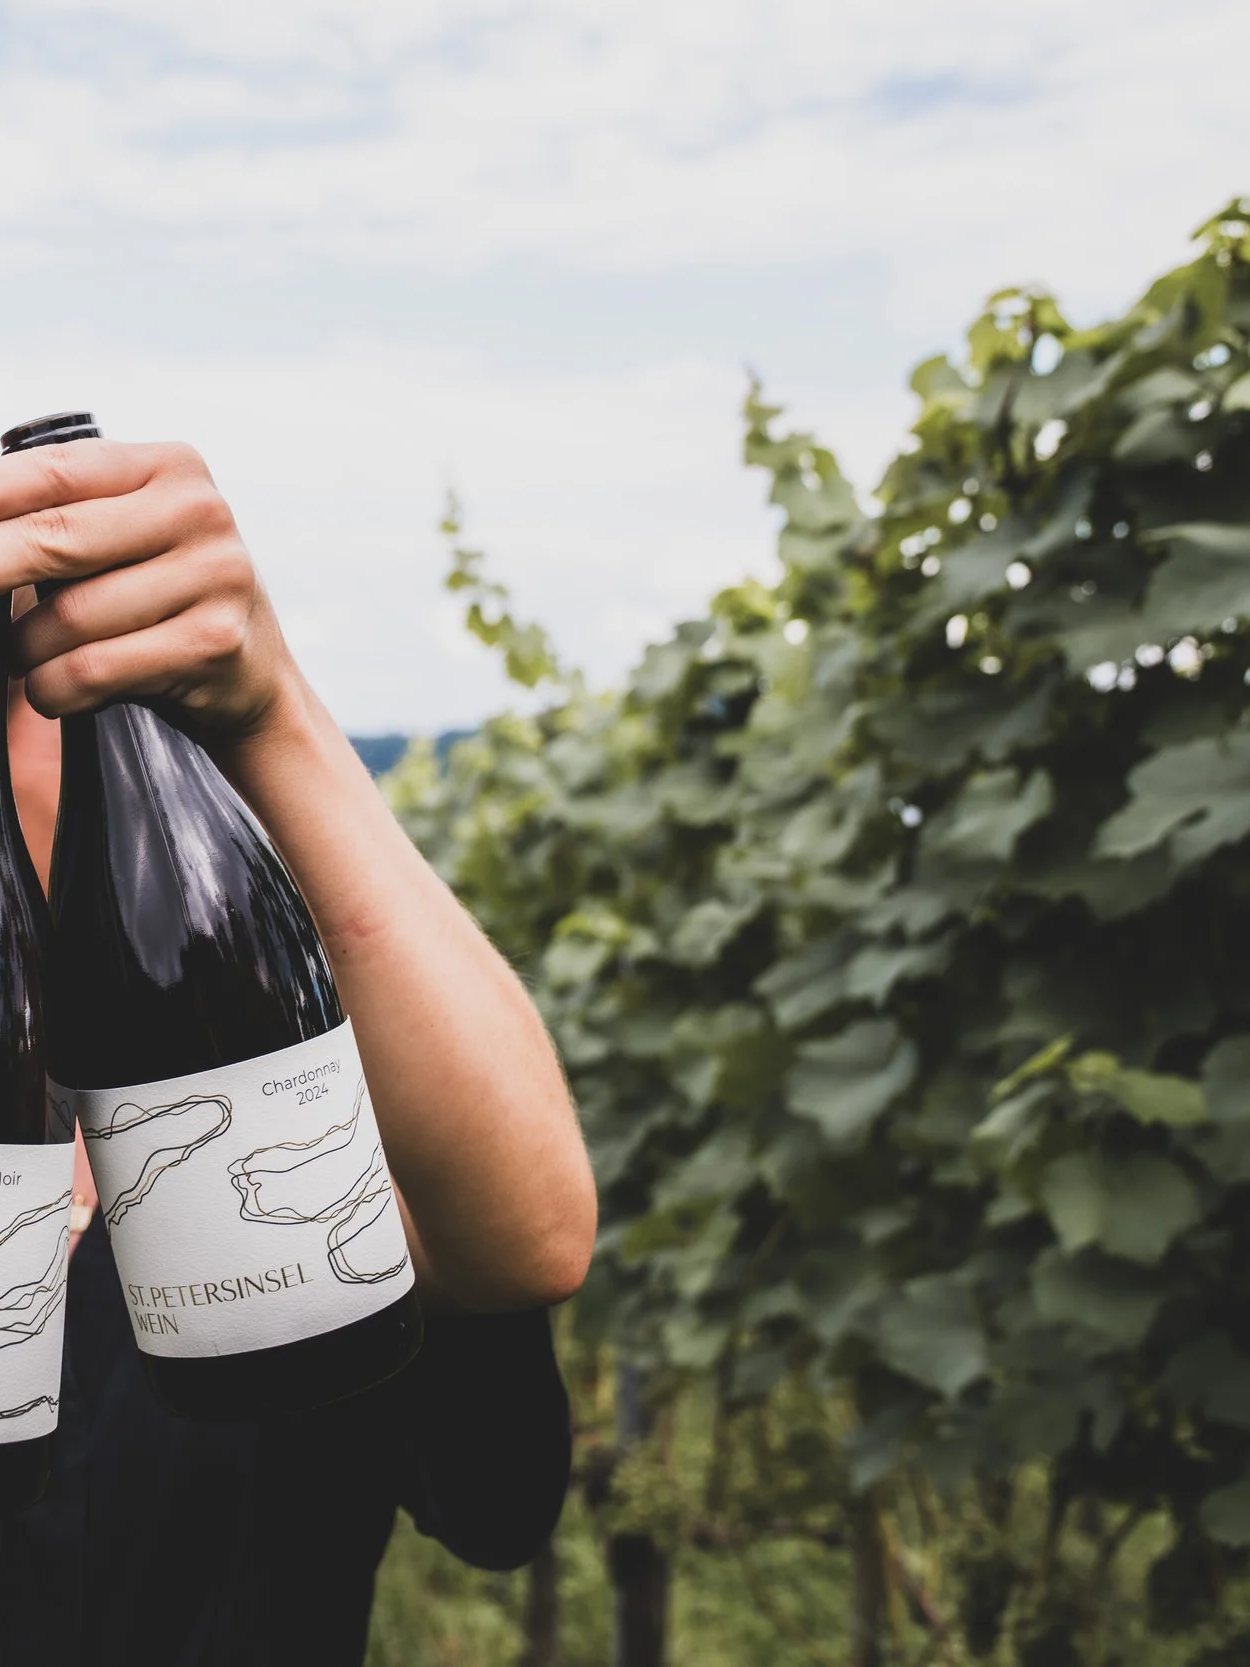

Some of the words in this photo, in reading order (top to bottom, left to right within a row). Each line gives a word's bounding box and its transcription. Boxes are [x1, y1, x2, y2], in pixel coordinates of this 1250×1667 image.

[261, 1059, 341, 1097] Chardonnay
[295, 1082, 329, 1106] 2024
[134, 1310, 180, 1335] WEIN
